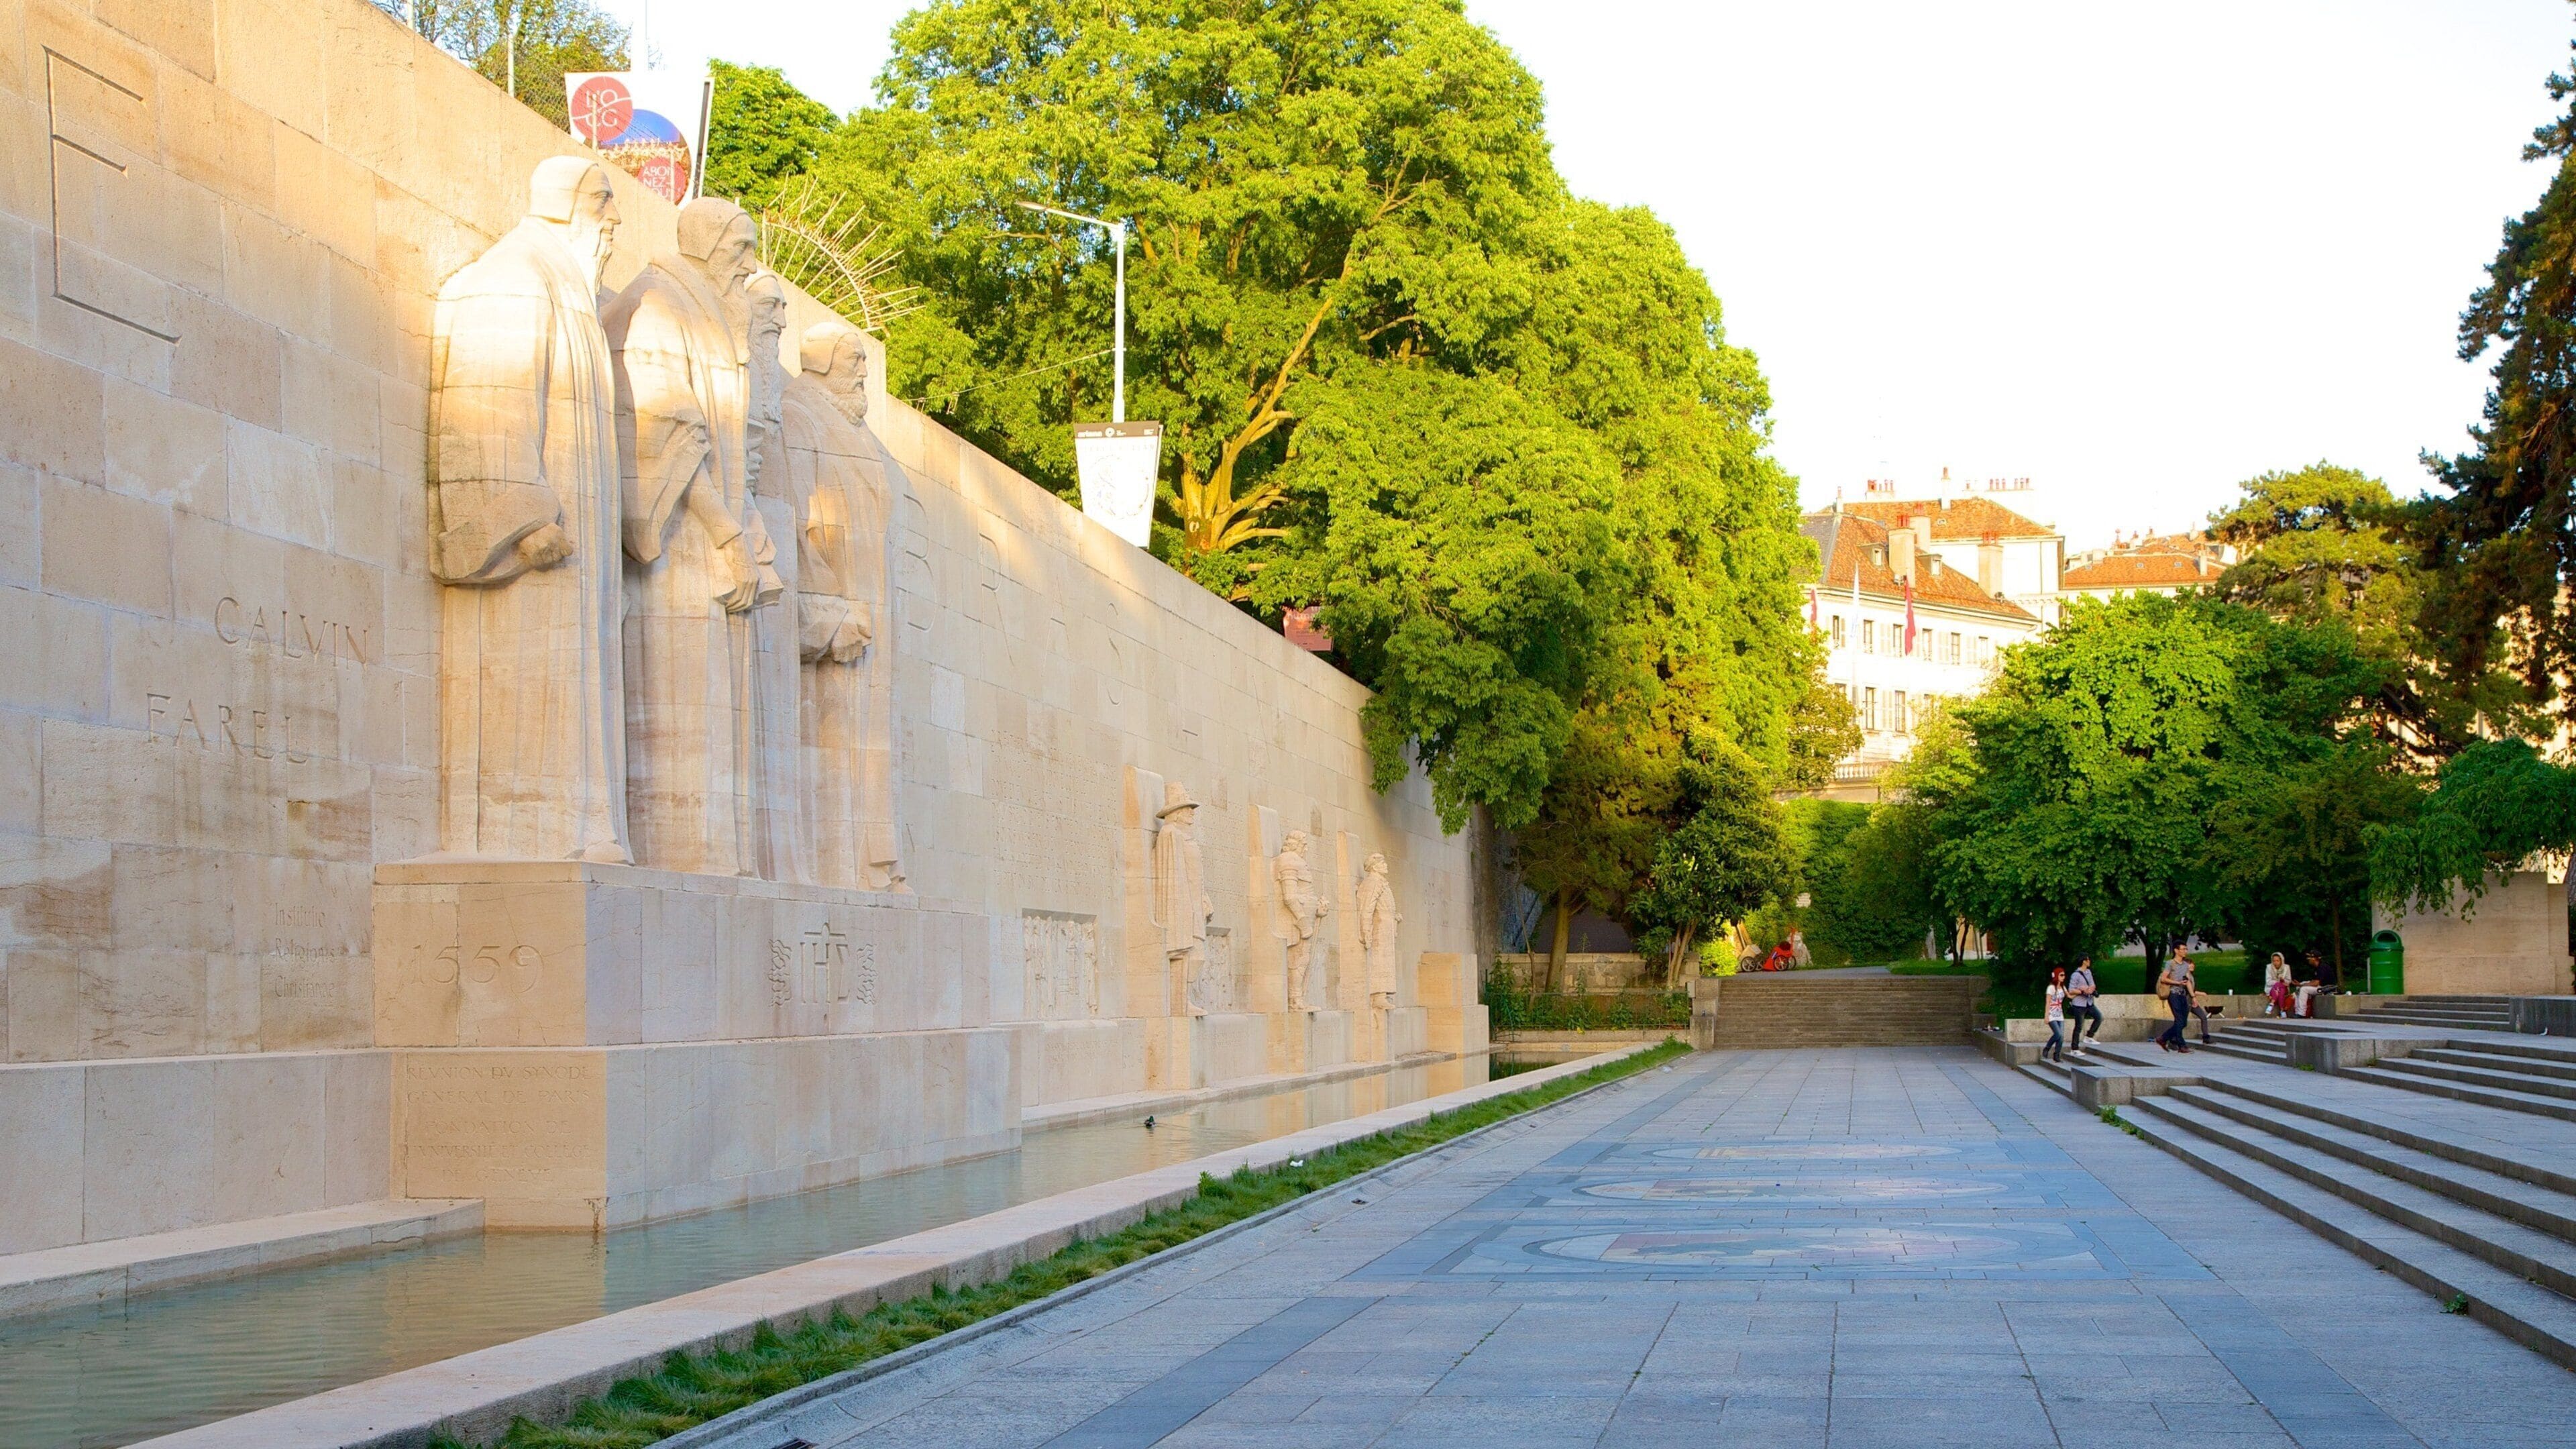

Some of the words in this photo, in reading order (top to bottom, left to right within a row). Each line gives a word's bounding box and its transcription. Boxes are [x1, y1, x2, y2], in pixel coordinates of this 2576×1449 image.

[215, 596, 369, 671] CALVIN
[145, 692, 311, 766] FAREL
[523, 1065, 593, 1079] SYNODE
[503, 1089, 527, 1104] DE
[538, 1089, 590, 1104] PARIS
[425, 1120, 535, 1134] FONDATION
[546, 1120, 572, 1134] DE
[443, 1169, 465, 1182] DE
